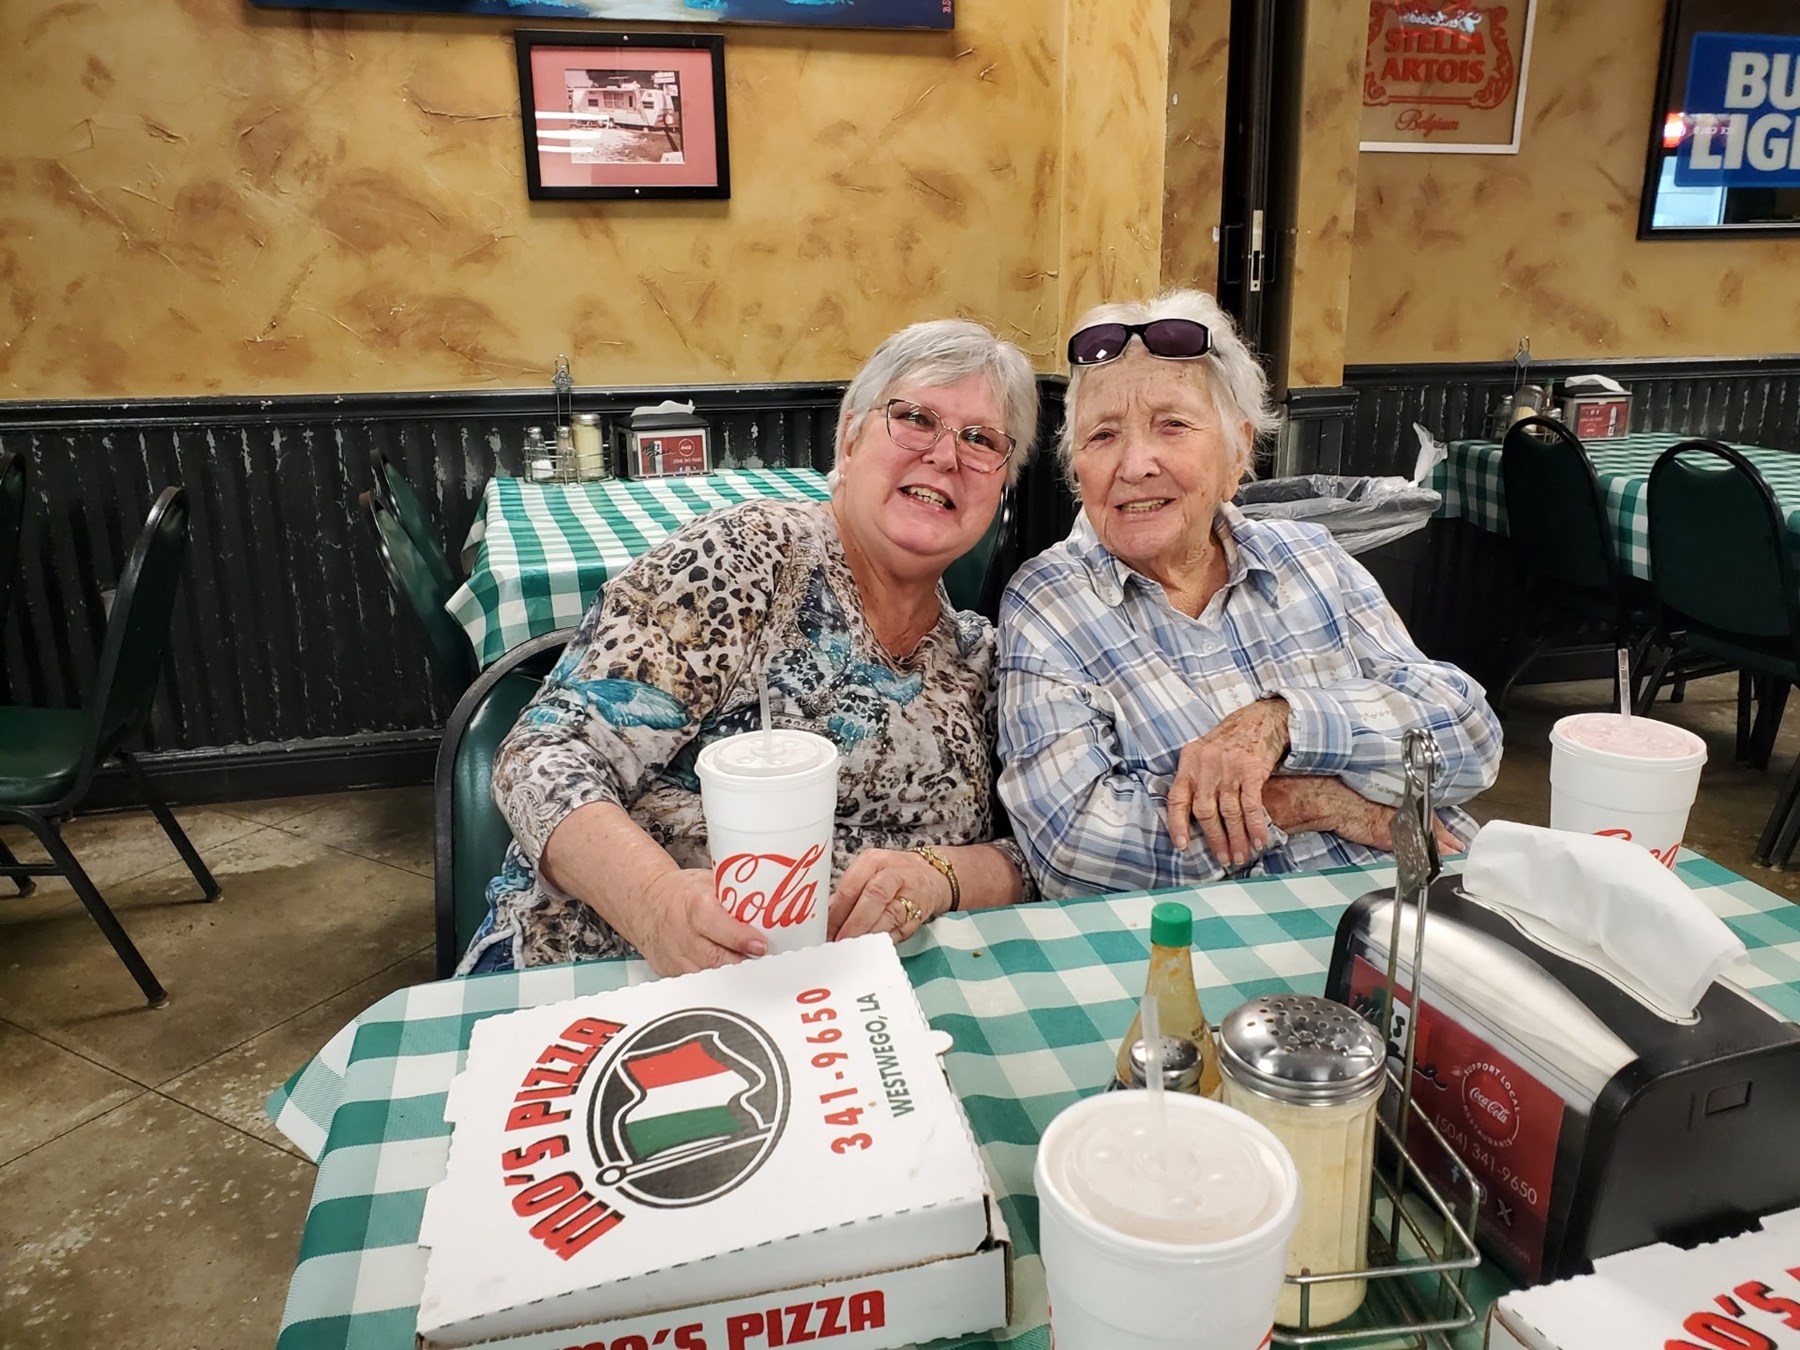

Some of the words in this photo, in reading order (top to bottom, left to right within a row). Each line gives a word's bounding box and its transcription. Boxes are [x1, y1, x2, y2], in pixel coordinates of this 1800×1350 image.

[1381, 58, 1486, 84] ARTOIS
[1384, 28, 1486, 55] STELLA
[715, 838, 829, 930] Cola
[856, 992, 881, 1012] LA
[505, 1017, 628, 1131] PIZZA
[796, 988, 873, 1154] 341-9650
[864, 1015, 915, 1118] WESTWEGO,
[1463, 1062, 1501, 1077] SUPPORT
[1500, 1073, 1521, 1112] LOCAL
[1434, 1113, 1468, 1151] (504)
[1471, 1143, 1538, 1205] 341-9650
[559, 1322, 707, 1350] 'S
[726, 1290, 886, 1350] PIZZA
[1664, 1280, 1800, 1350] O'S
